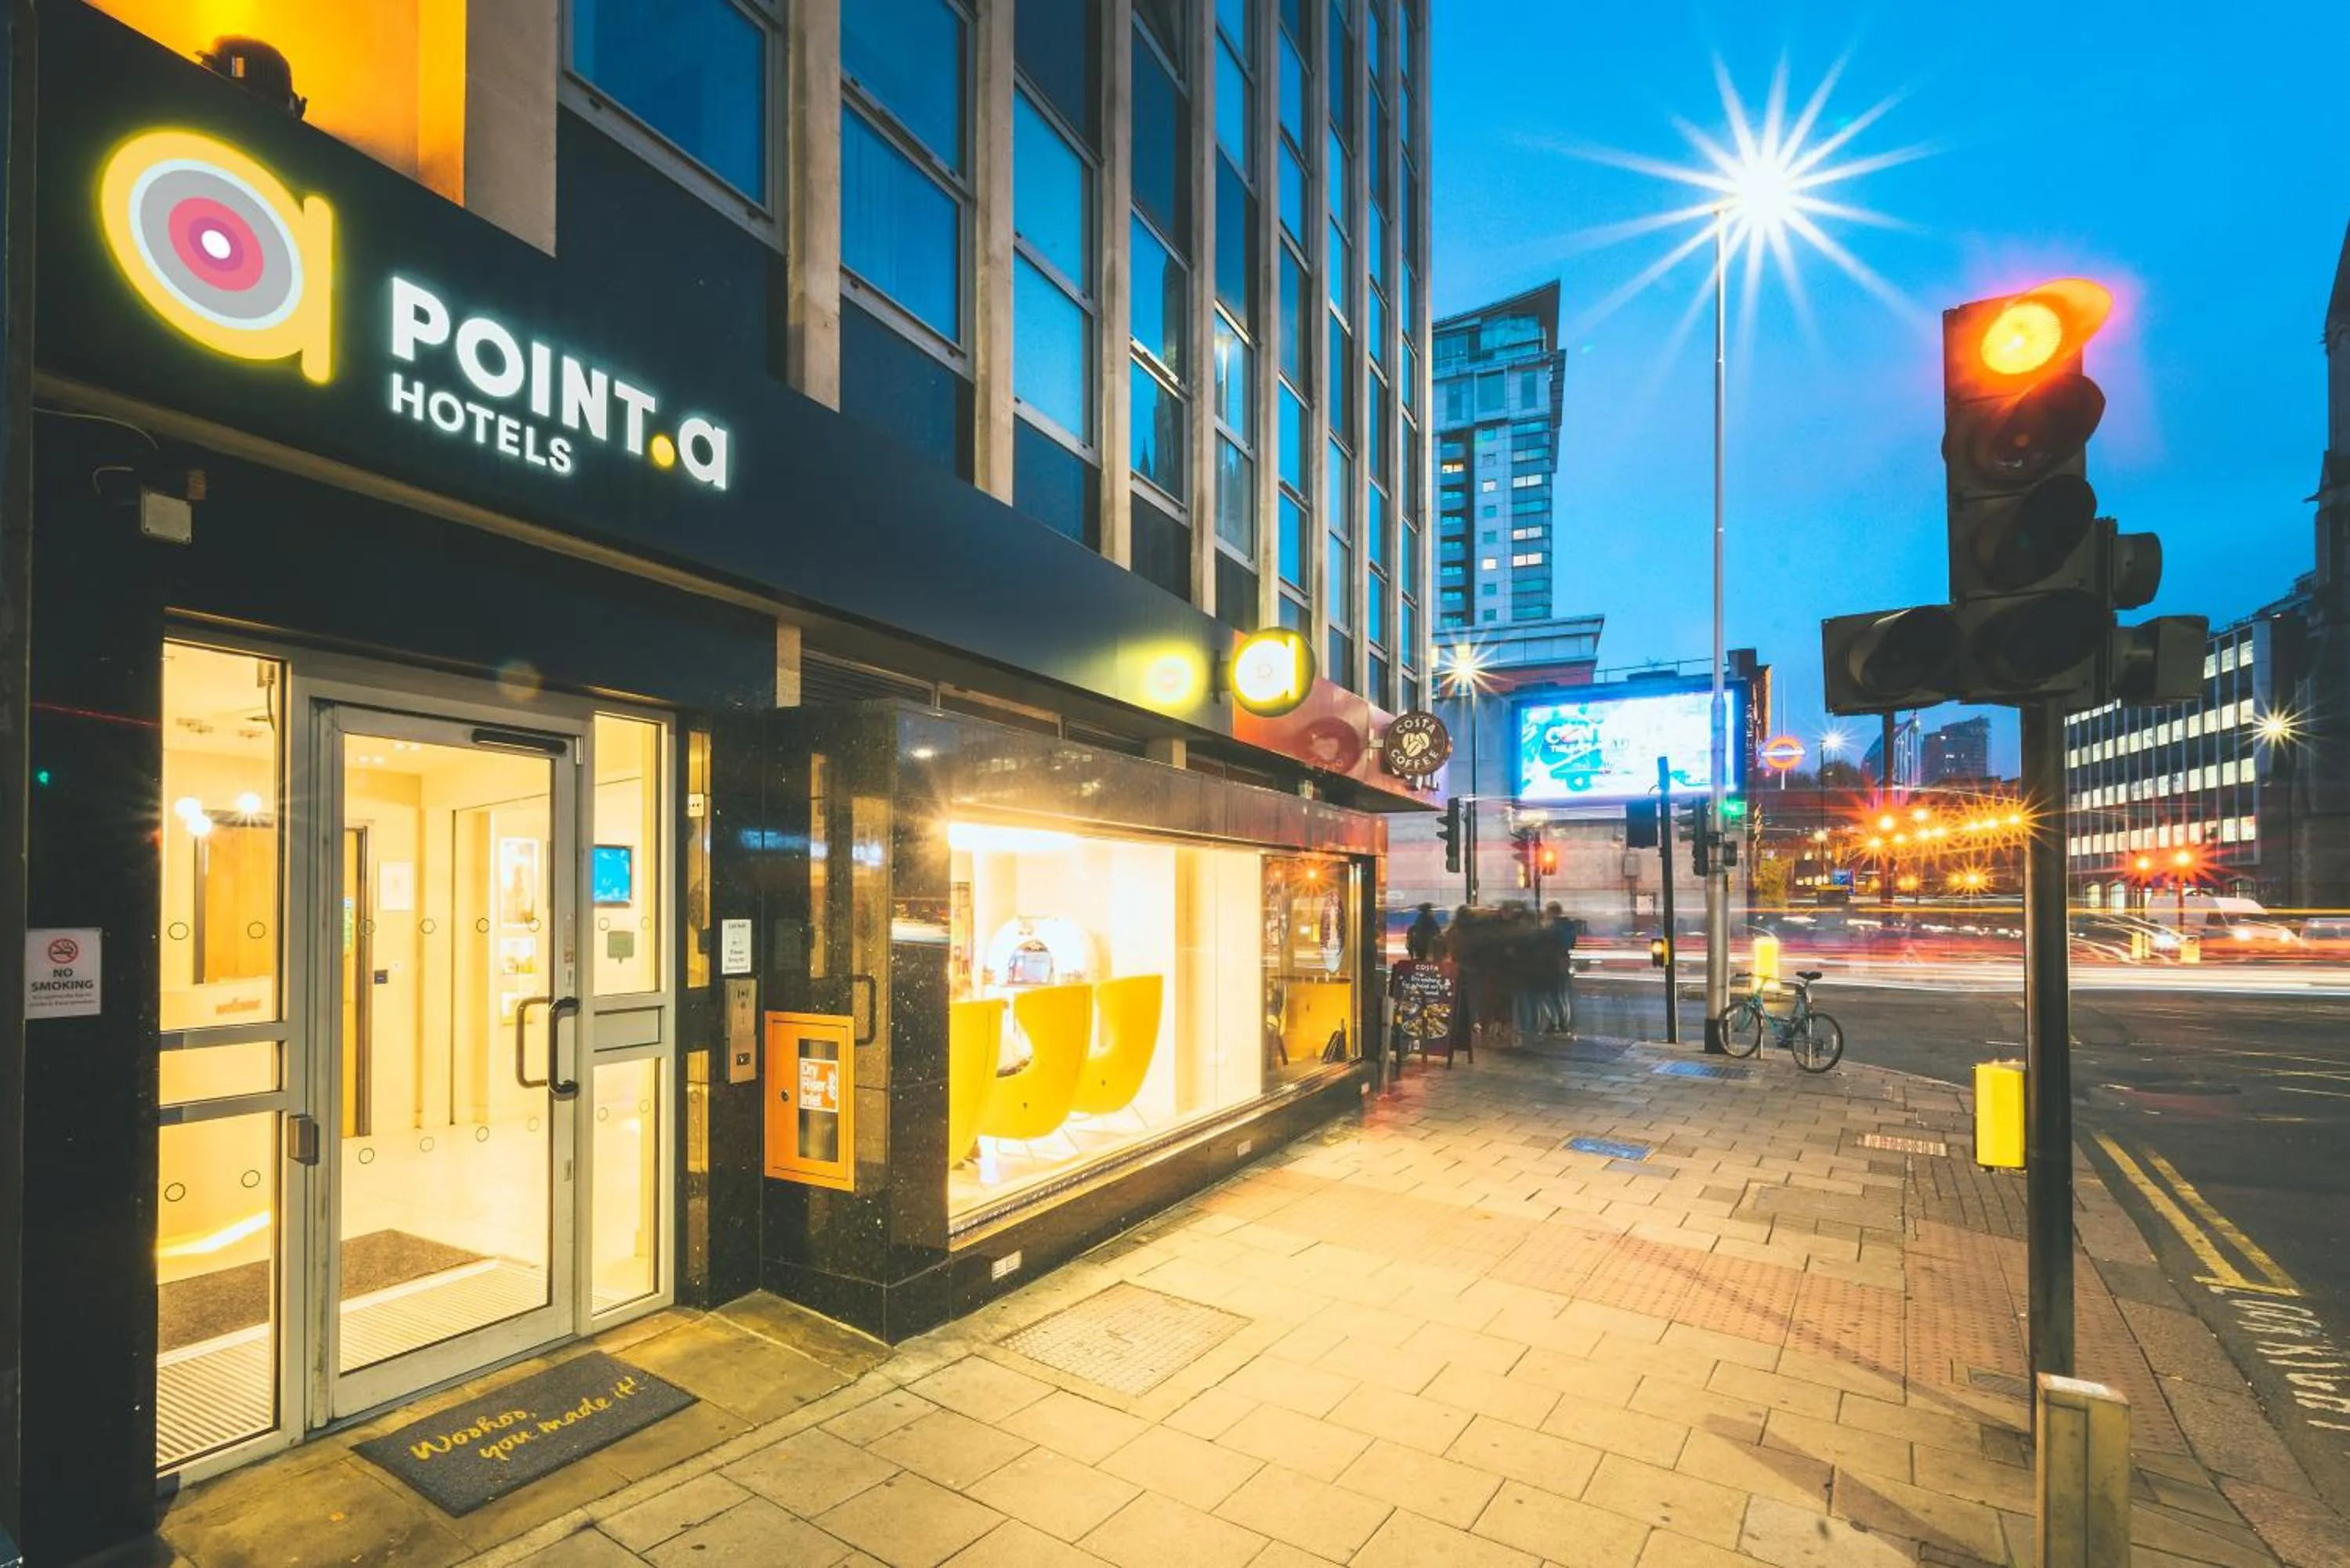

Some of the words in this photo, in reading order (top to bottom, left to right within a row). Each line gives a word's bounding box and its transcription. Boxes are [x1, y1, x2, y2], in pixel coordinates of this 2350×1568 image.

[392, 373, 573, 475] HOTELS
[1396, 717, 1436, 734] COSTA
[1390, 749, 1439, 768] COFFEE
[52, 968, 74, 977] NO
[31, 979, 94, 992] SMOKING
[537, 1396, 613, 1433] made
